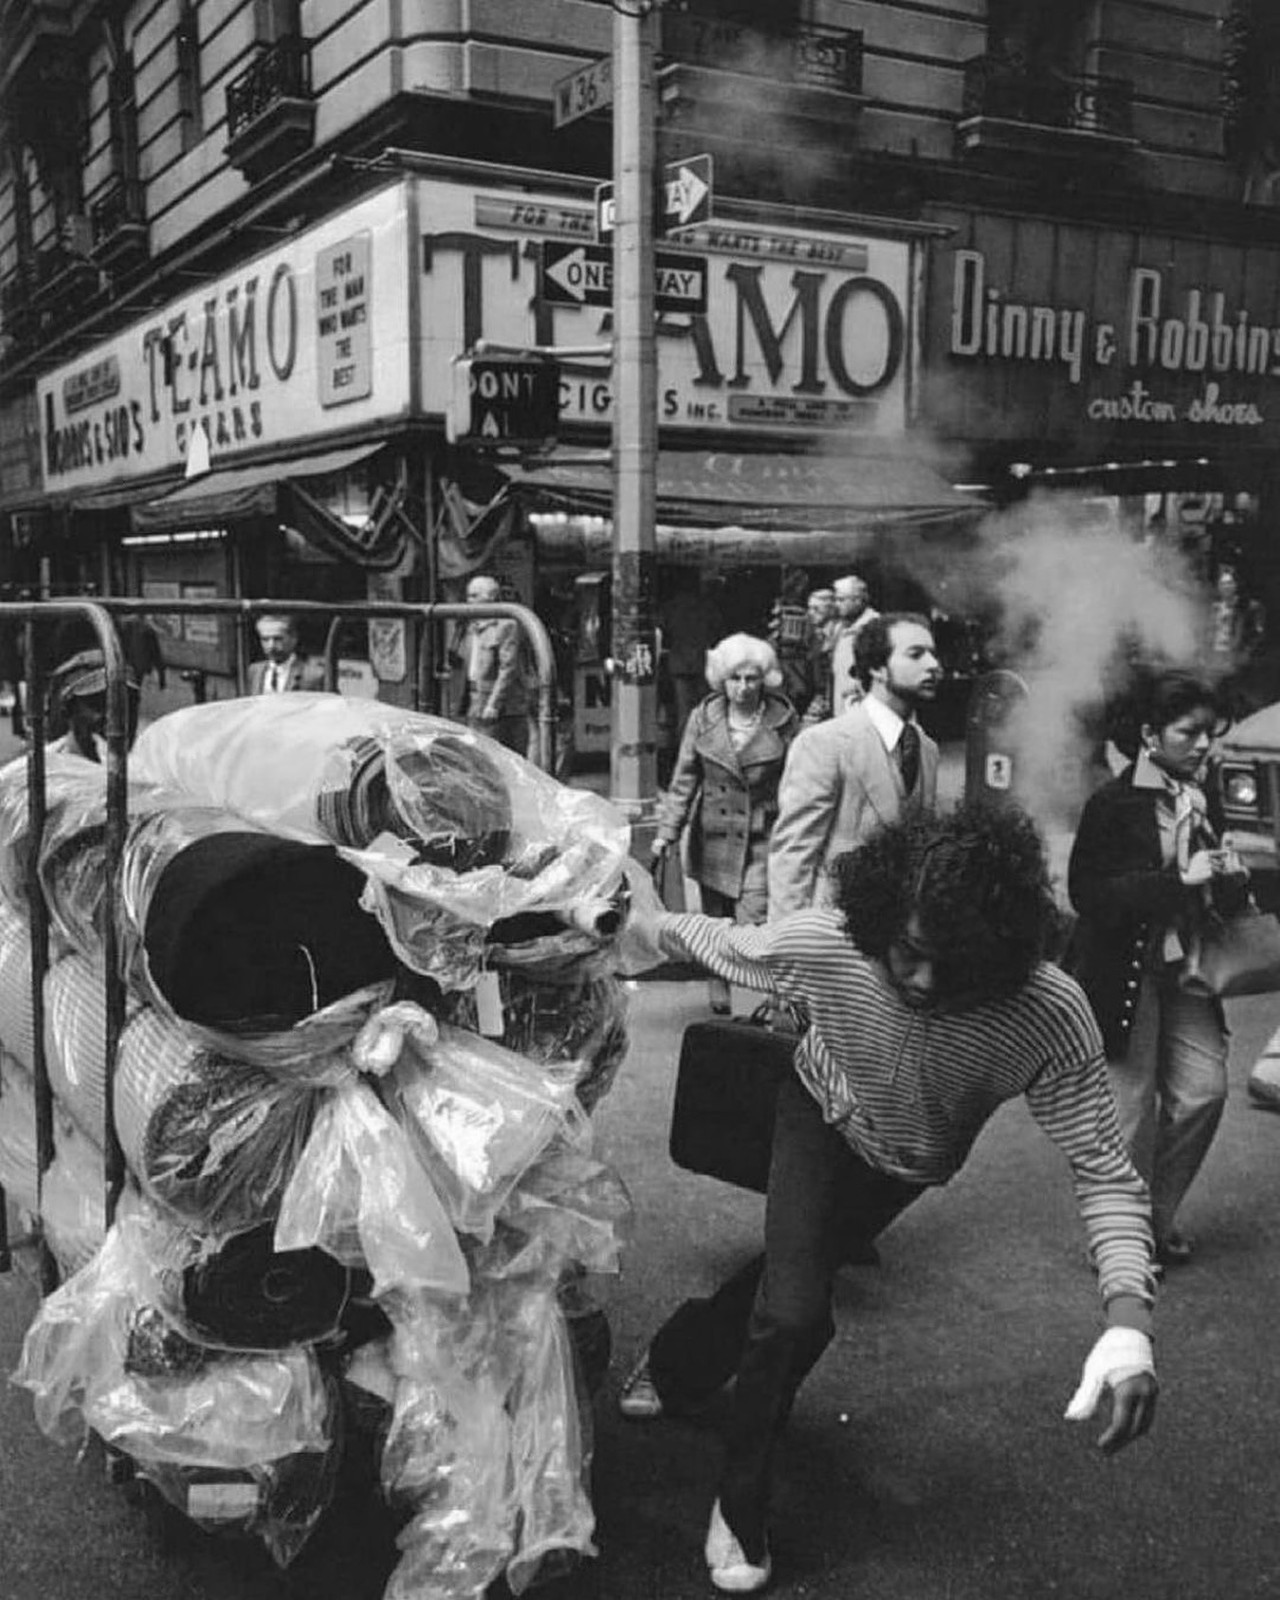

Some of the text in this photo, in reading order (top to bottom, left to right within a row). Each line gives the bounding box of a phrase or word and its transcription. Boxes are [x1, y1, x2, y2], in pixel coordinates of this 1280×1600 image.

[559, 85, 571, 117] W
[577, 72, 597, 112] 36
[511, 205, 548, 226] FOR
[560, 211, 595, 232] THE
[707, 232, 759, 252] WANTS
[768, 239, 797, 257] THE
[807, 244, 843, 262] BEST
[333, 251, 351, 279] FOR
[567, 262, 613, 286] ONE
[320, 286, 337, 309] THE
[952, 249, 1084, 383] Dinny
[1096, 324, 1116, 364] &
[335, 337, 352, 359] THE
[332, 364, 356, 390] BEST
[687, 403, 723, 419] INC.
[1087, 381, 1264, 425] custom shoes
